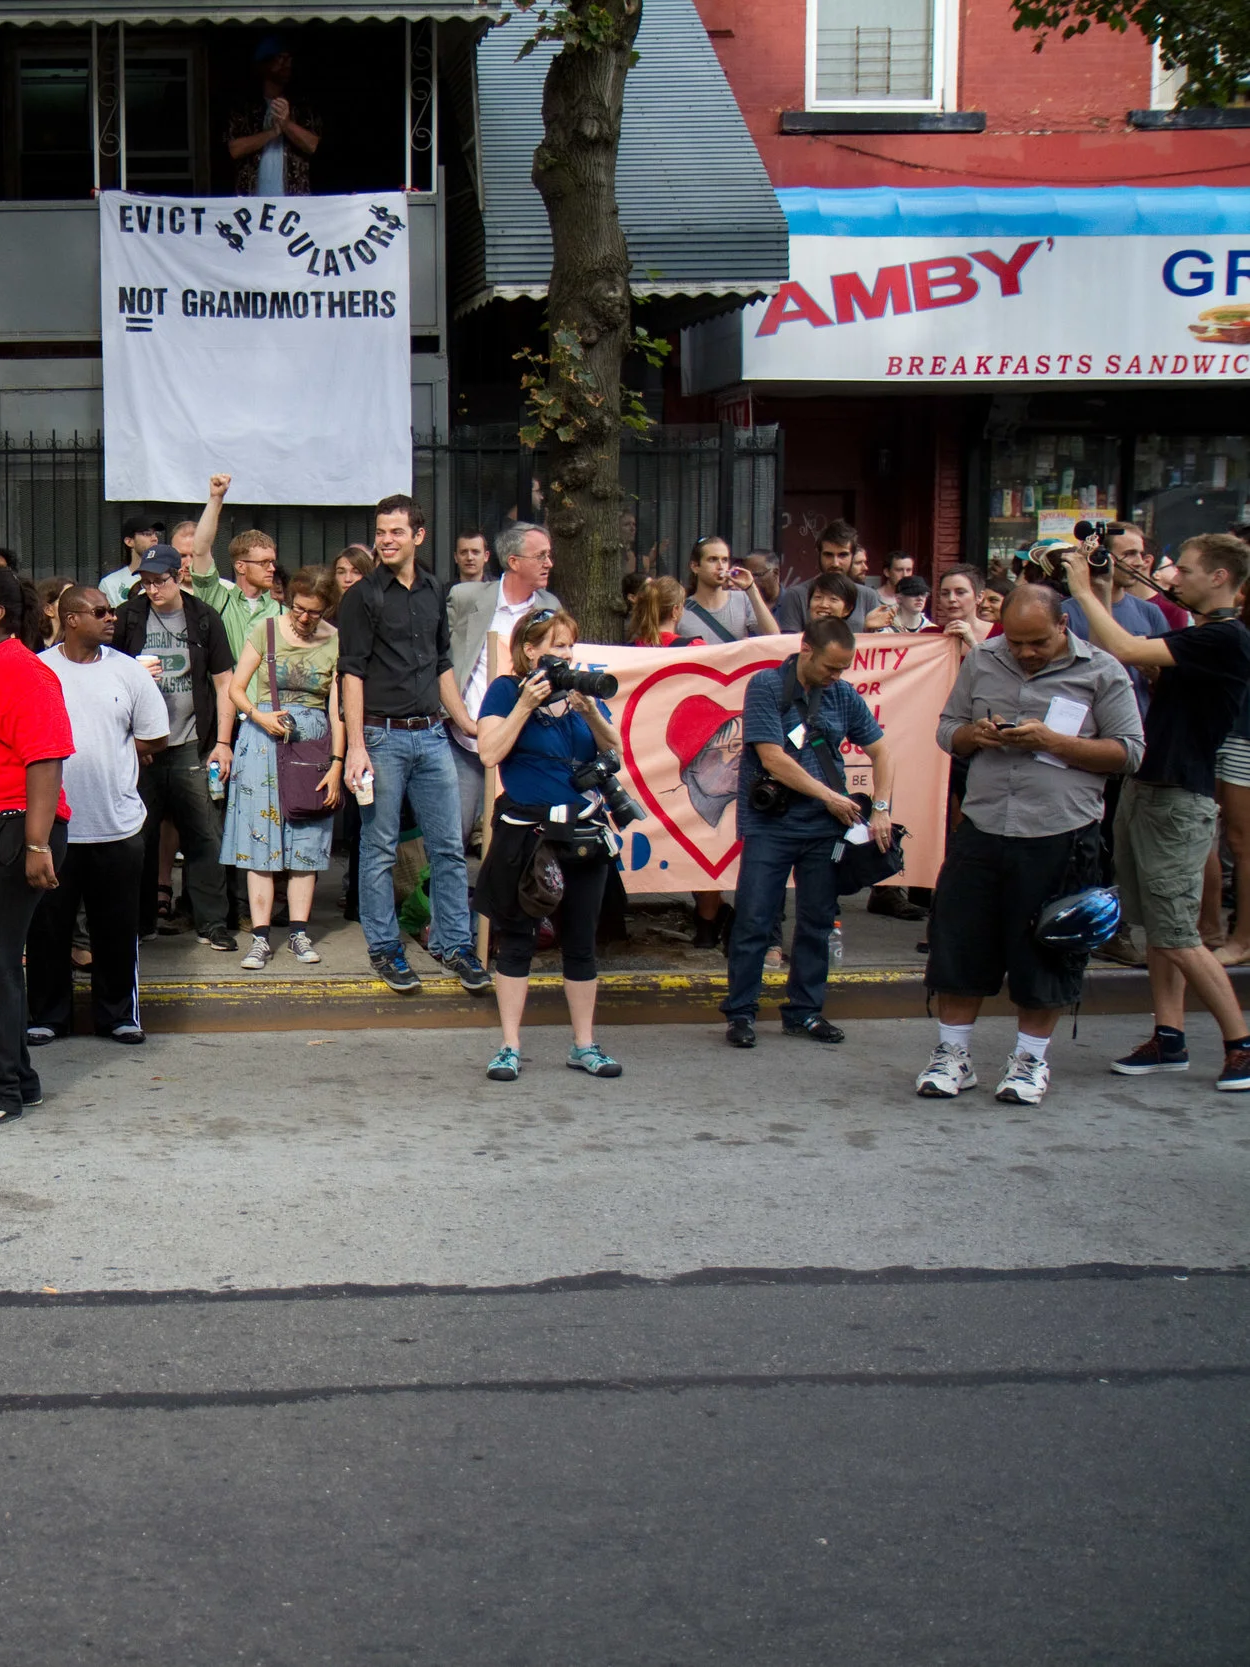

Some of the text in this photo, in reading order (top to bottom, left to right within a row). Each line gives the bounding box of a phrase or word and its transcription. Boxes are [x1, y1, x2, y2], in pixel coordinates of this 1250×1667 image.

[119, 204, 206, 235] EVICT
[118, 286, 397, 320] NOT GRANDMOTHERS
[886, 354, 1250, 376] BREAKFASTS SANDWIC
[853, 647, 909, 671] NITY
[851, 681, 881, 695] OR
[852, 774, 868, 787] BE
